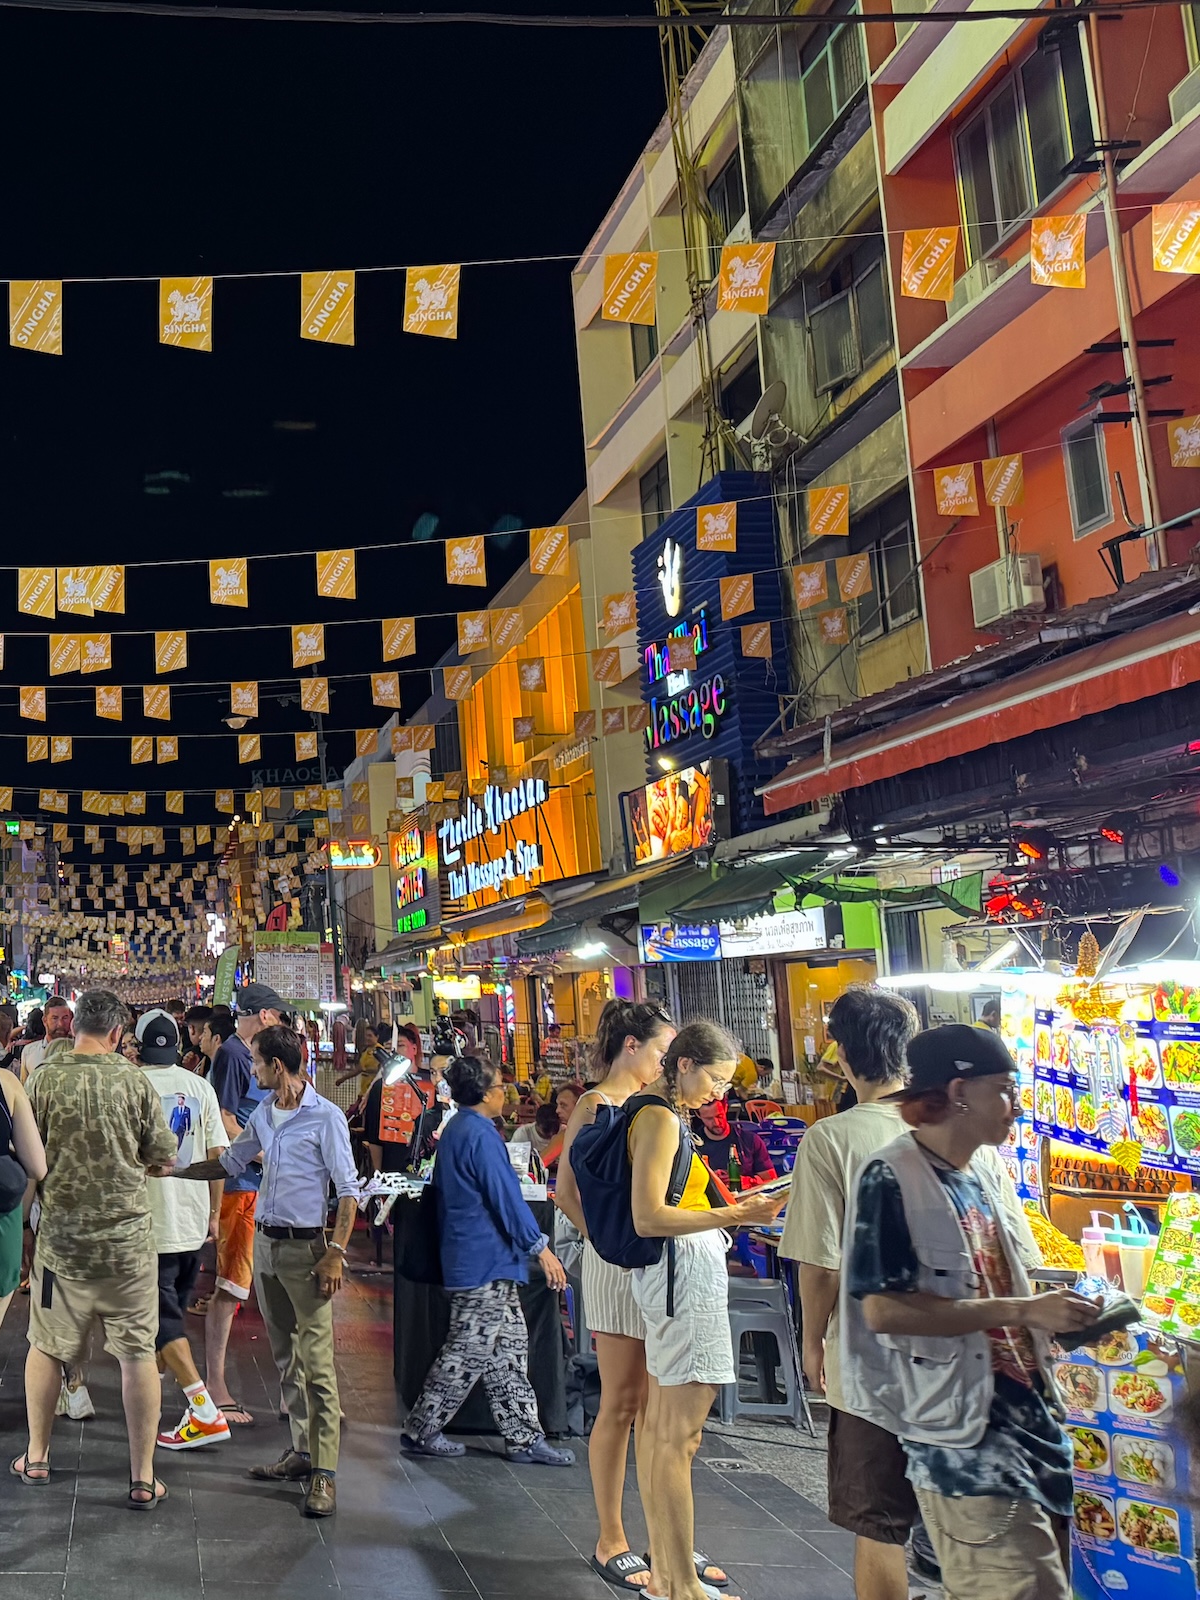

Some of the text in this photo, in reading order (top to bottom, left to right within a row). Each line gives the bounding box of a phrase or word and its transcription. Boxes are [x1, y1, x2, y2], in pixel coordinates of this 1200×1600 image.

[1161, 210, 1200, 268] SINGHA
[906, 236, 951, 292] SINGHA
[609, 262, 652, 318] SINGHA
[722, 286, 764, 299] SINGHA
[17, 290, 56, 344] SINGHA
[307, 280, 349, 336] SINGHA
[409, 311, 452, 322] SINGHA
[164, 324, 207, 334] SINGHA
[991, 461, 1018, 503] SINGHA
[815, 491, 845, 532] SINGHA
[940, 497, 974, 509] SINGHA
[535, 532, 564, 571] SINGHA
[700, 533, 732, 543] SINGHA
[323, 556, 350, 594] SINGHA
[450, 568, 482, 577] SINGHA
[843, 559, 867, 594] SINGHA
[24, 574, 51, 610] SINGHA
[95, 572, 121, 608] SINGHA
[213, 588, 244, 596] SINGHA
[726, 579, 749, 613] SINGHA
[798, 588, 825, 599] SINGHA
[496, 612, 520, 646] SINGHA
[606, 618, 634, 627] SINGHA
[160, 636, 183, 667] SINGHA
[388, 622, 410, 655] SINGHA
[461, 636, 488, 644] SINGHA
[746, 626, 767, 655] SINGHA
[54, 639, 76, 669] SINGHA
[597, 652, 616, 680] SINGHA
[305, 682, 324, 709] SINGHA
[450, 670, 468, 698] SINGHA
[148, 690, 167, 716] SINGHA
[251, 766, 346, 784] KHAOSA
[448, 866, 468, 900] Thai
[516, 840, 539, 881] Spa
